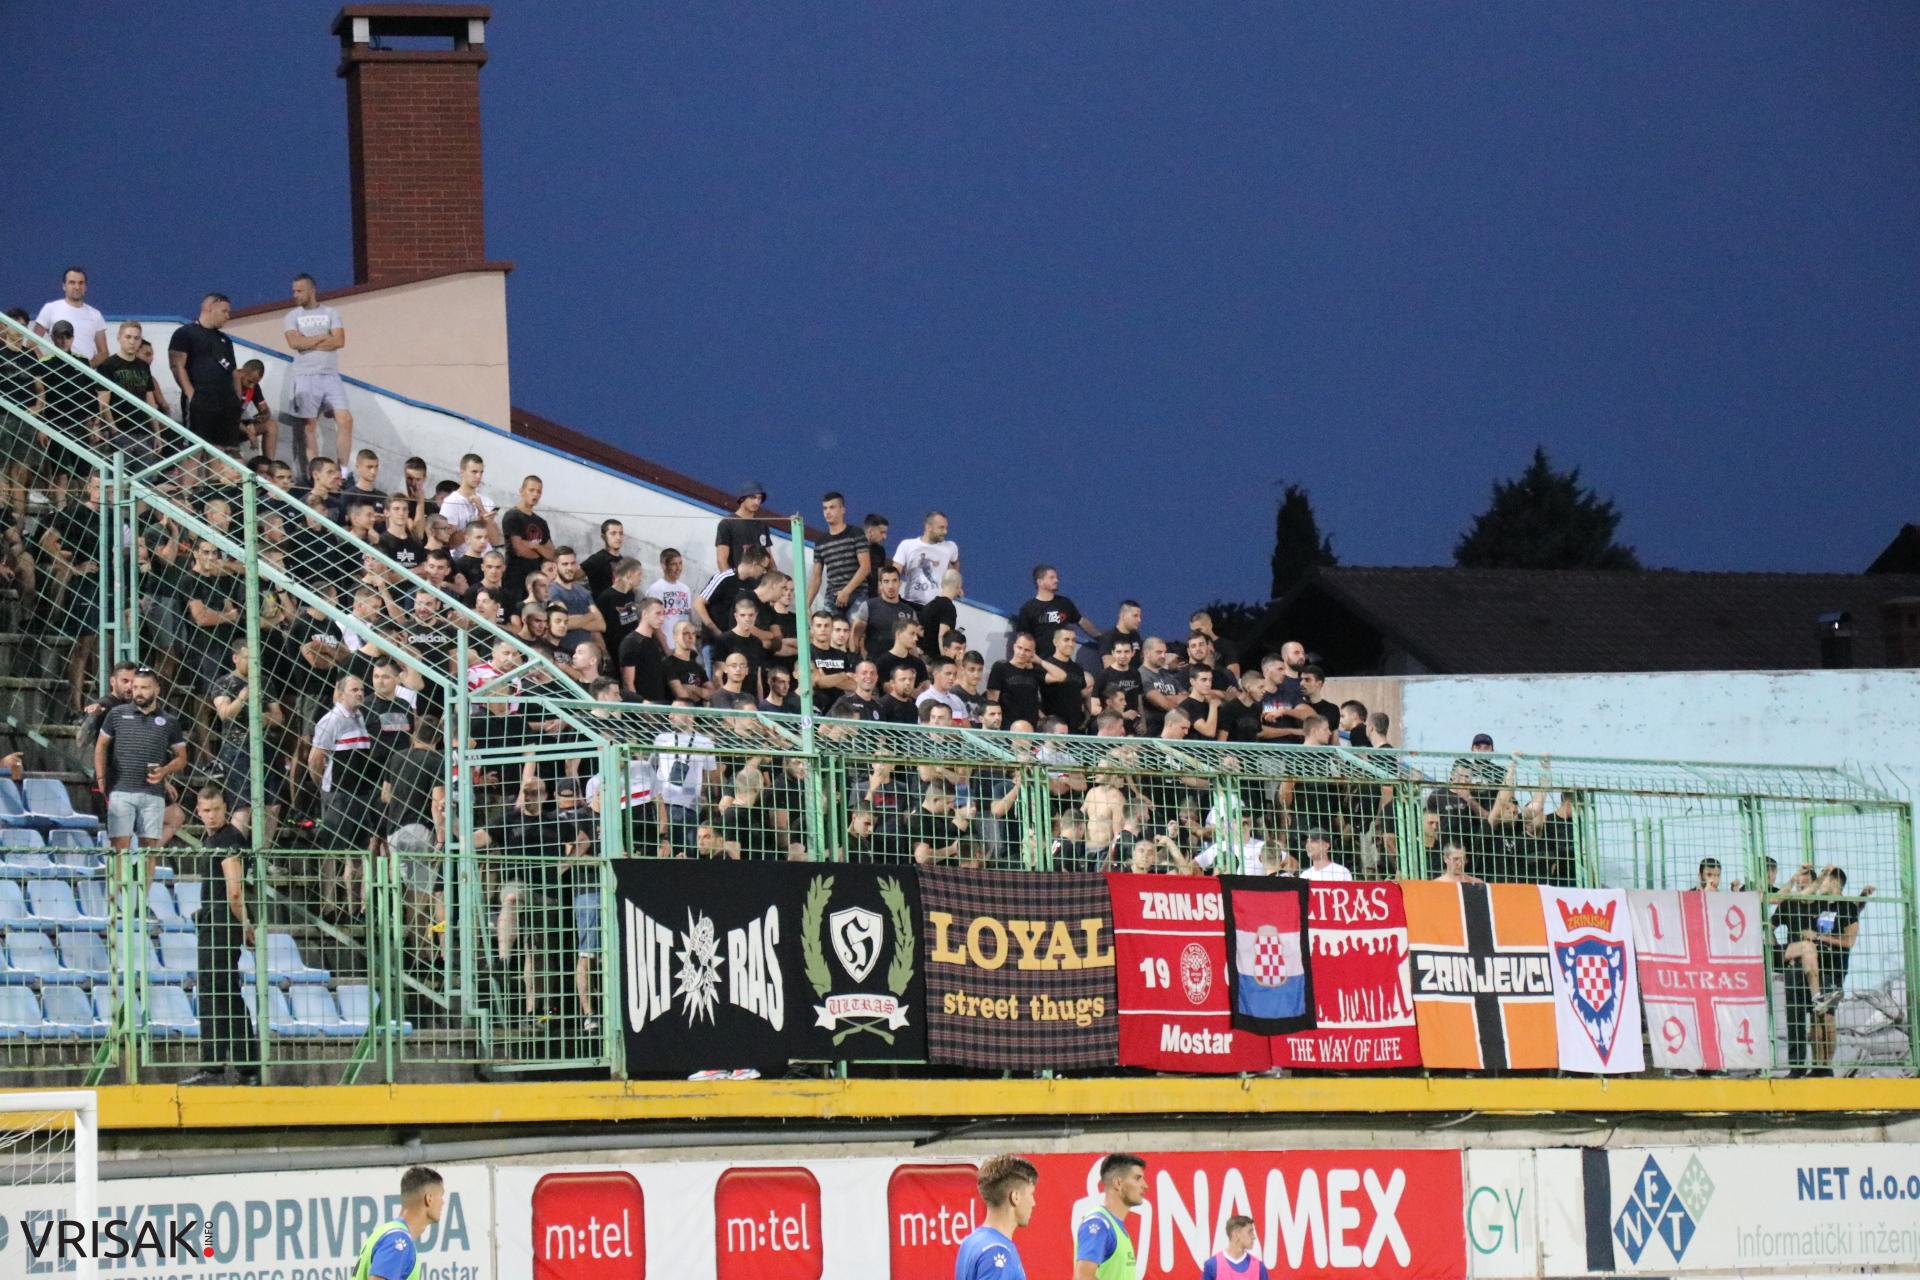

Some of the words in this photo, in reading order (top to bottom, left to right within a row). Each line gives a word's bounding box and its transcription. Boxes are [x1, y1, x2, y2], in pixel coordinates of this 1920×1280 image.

[929, 911, 1115, 971] LOYAL
[1725, 904, 1746, 942] 9
[1139, 957, 1171, 989] 19
[1418, 954, 1553, 993] ZRINJEVCI
[1657, 970, 1749, 991] ULTRAS
[829, 997, 895, 1015] ULTRAS
[943, 990, 1018, 1021] street
[1030, 994, 1105, 1027] thugs
[1160, 1024, 1233, 1054] Mostar
[1287, 1037, 1315, 1063] THE
[1319, 1035, 1351, 1062] WAY
[1354, 1037, 1371, 1062] OF
[1374, 1036, 1402, 1061] LIFE
[1662, 1015, 1686, 1054] 9
[1797, 1167, 1850, 1200] NET
[545, 1209, 632, 1260] m:tel
[728, 1203, 809, 1252] m:tel
[899, 1198, 975, 1246] m:tel
[1737, 1223, 1851, 1257] Informatički
[1858, 1221, 1920, 1261] inženj
